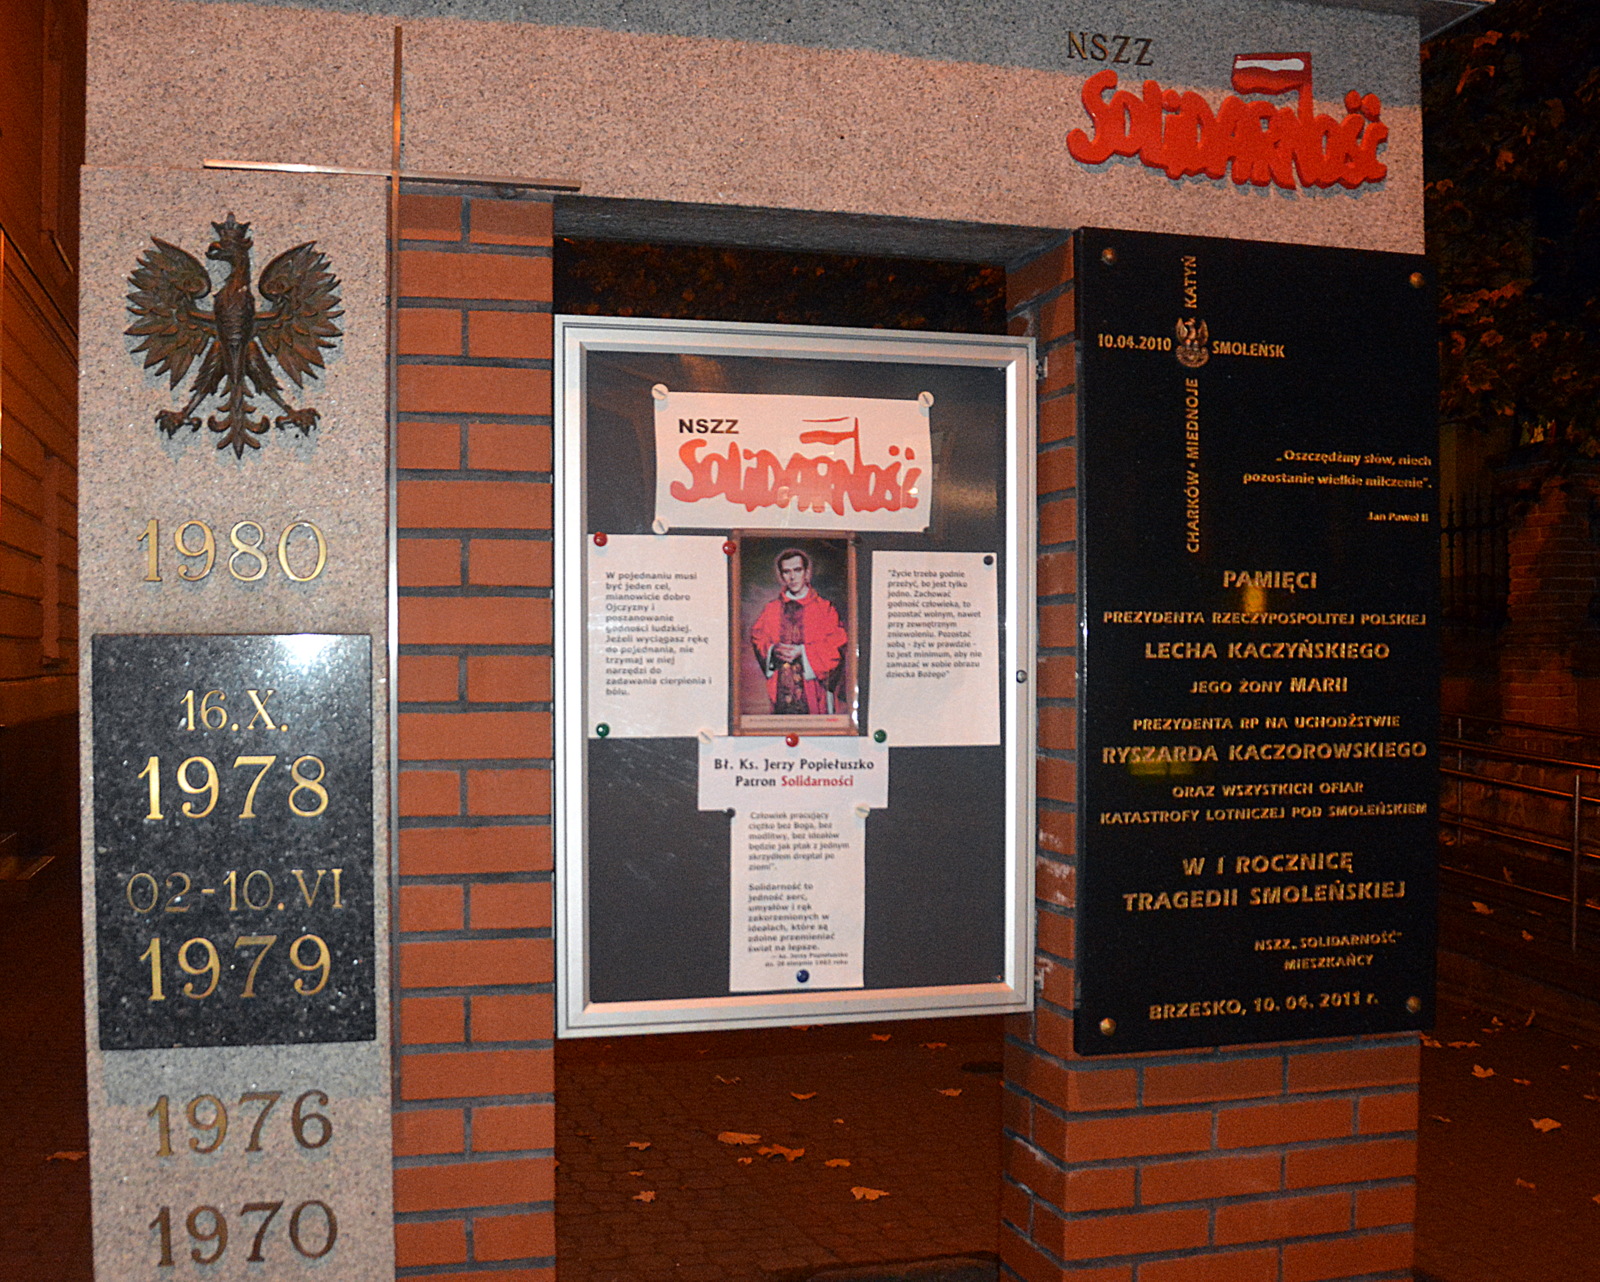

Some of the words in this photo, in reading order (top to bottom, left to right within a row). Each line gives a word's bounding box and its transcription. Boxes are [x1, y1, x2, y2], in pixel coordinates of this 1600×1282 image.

[1067, 31, 1154, 66] NSZZ
[1180, 255, 1197, 309] KATYŃ
[1098, 333, 1172, 351] 10.04.2010
[1212, 339, 1285, 358] SMOLEŃSK
[1186, 377, 1198, 460] MIEDNOJE
[678, 418, 739, 434] NSZZ
[1398, 455, 1432, 467] niech
[1243, 471, 1315, 486] pozostanie
[1317, 473, 1362, 487] wielkie
[1186, 470, 1199, 553] CHARKÓW
[1368, 511, 1386, 522] Jan
[136, 518, 329, 583] 1980
[606, 571, 615, 579] W
[618, 572, 672, 581] pojednaniu
[939, 570, 965, 578] godnie
[606, 582, 623, 591] być
[625, 582, 652, 591] jeden
[1222, 570, 1317, 593] PAMIĘCI
[606, 593, 660, 601] mianowicie
[663, 593, 691, 601] dobro
[606, 603, 649, 612] Ojczyzny
[887, 601, 919, 609] godność
[887, 610, 921, 618] pozostać
[1103, 611, 1205, 624] PREZYDENTA
[1212, 611, 1354, 625] RZECZYPOSPOLITEJ
[1360, 613, 1426, 625] POLSKIEJ
[887, 621, 904, 629] przy
[906, 621, 957, 629] zewnętrznym
[636, 636, 684, 644] wyciągasz
[688, 636, 709, 644] rękę
[897, 651, 912, 659] jest
[1145, 642, 1218, 659] LECHA
[1227, 639, 1390, 659] KACZYŃSKIEGO
[606, 657, 643, 665] trzymaj
[657, 657, 675, 665] niej
[606, 667, 647, 675] narzędzi
[606, 677, 656, 685] zadawania
[660, 678, 706, 686] cierpienia
[1189, 680, 1232, 694] JEGO
[1239, 678, 1283, 693] ŻONY
[1289, 677, 1348, 693] MARII
[1132, 717, 1233, 731] PREZYDENTA
[1240, 717, 1259, 730] RP
[1265, 716, 1289, 729] NA
[1101, 745, 1218, 764] RYSZARDA
[1229, 741, 1427, 761] KACZOROWSKIEGO
[740, 758, 759, 770] Ks.
[764, 758, 794, 772] Jerzy
[800, 758, 874, 772] Popiełuszko
[136, 754, 330, 821] 1978
[735, 775, 776, 787] Patron
[781, 775, 854, 787] Solidarności
[1172, 785, 1215, 798] ORAZ
[1222, 783, 1313, 796] WSZYSTKICH
[1319, 781, 1364, 795] OFIAR
[1100, 809, 1199, 825] KATASTROFY
[1206, 806, 1284, 821] LOTNICZEJ
[1292, 805, 1322, 818] POD
[1328, 801, 1427, 817] SMOLEŃSKIEM
[1183, 857, 1205, 875] W
[1235, 851, 1354, 874] ROCZNICĘ
[749, 882, 802, 891] Solidarność
[748, 893, 783, 902] jedność
[1123, 888, 1238, 911] TRAGEDII
[1249, 879, 1406, 906] SMOLEŃSKIEJ
[748, 913, 819, 922] zakorzenionych
[791, 923, 815, 931] które
[748, 934, 777, 942] zdolne
[1255, 937, 1291, 951] NSZZ
[139, 934, 331, 1001] 1979
[1284, 953, 1373, 971] MIESZKAŃCY
[1149, 999, 1247, 1020] BRZESKO,
[1319, 992, 1361, 1008] 2011
[147, 1089, 333, 1157] 1976
[148, 1199, 339, 1268] 1970
